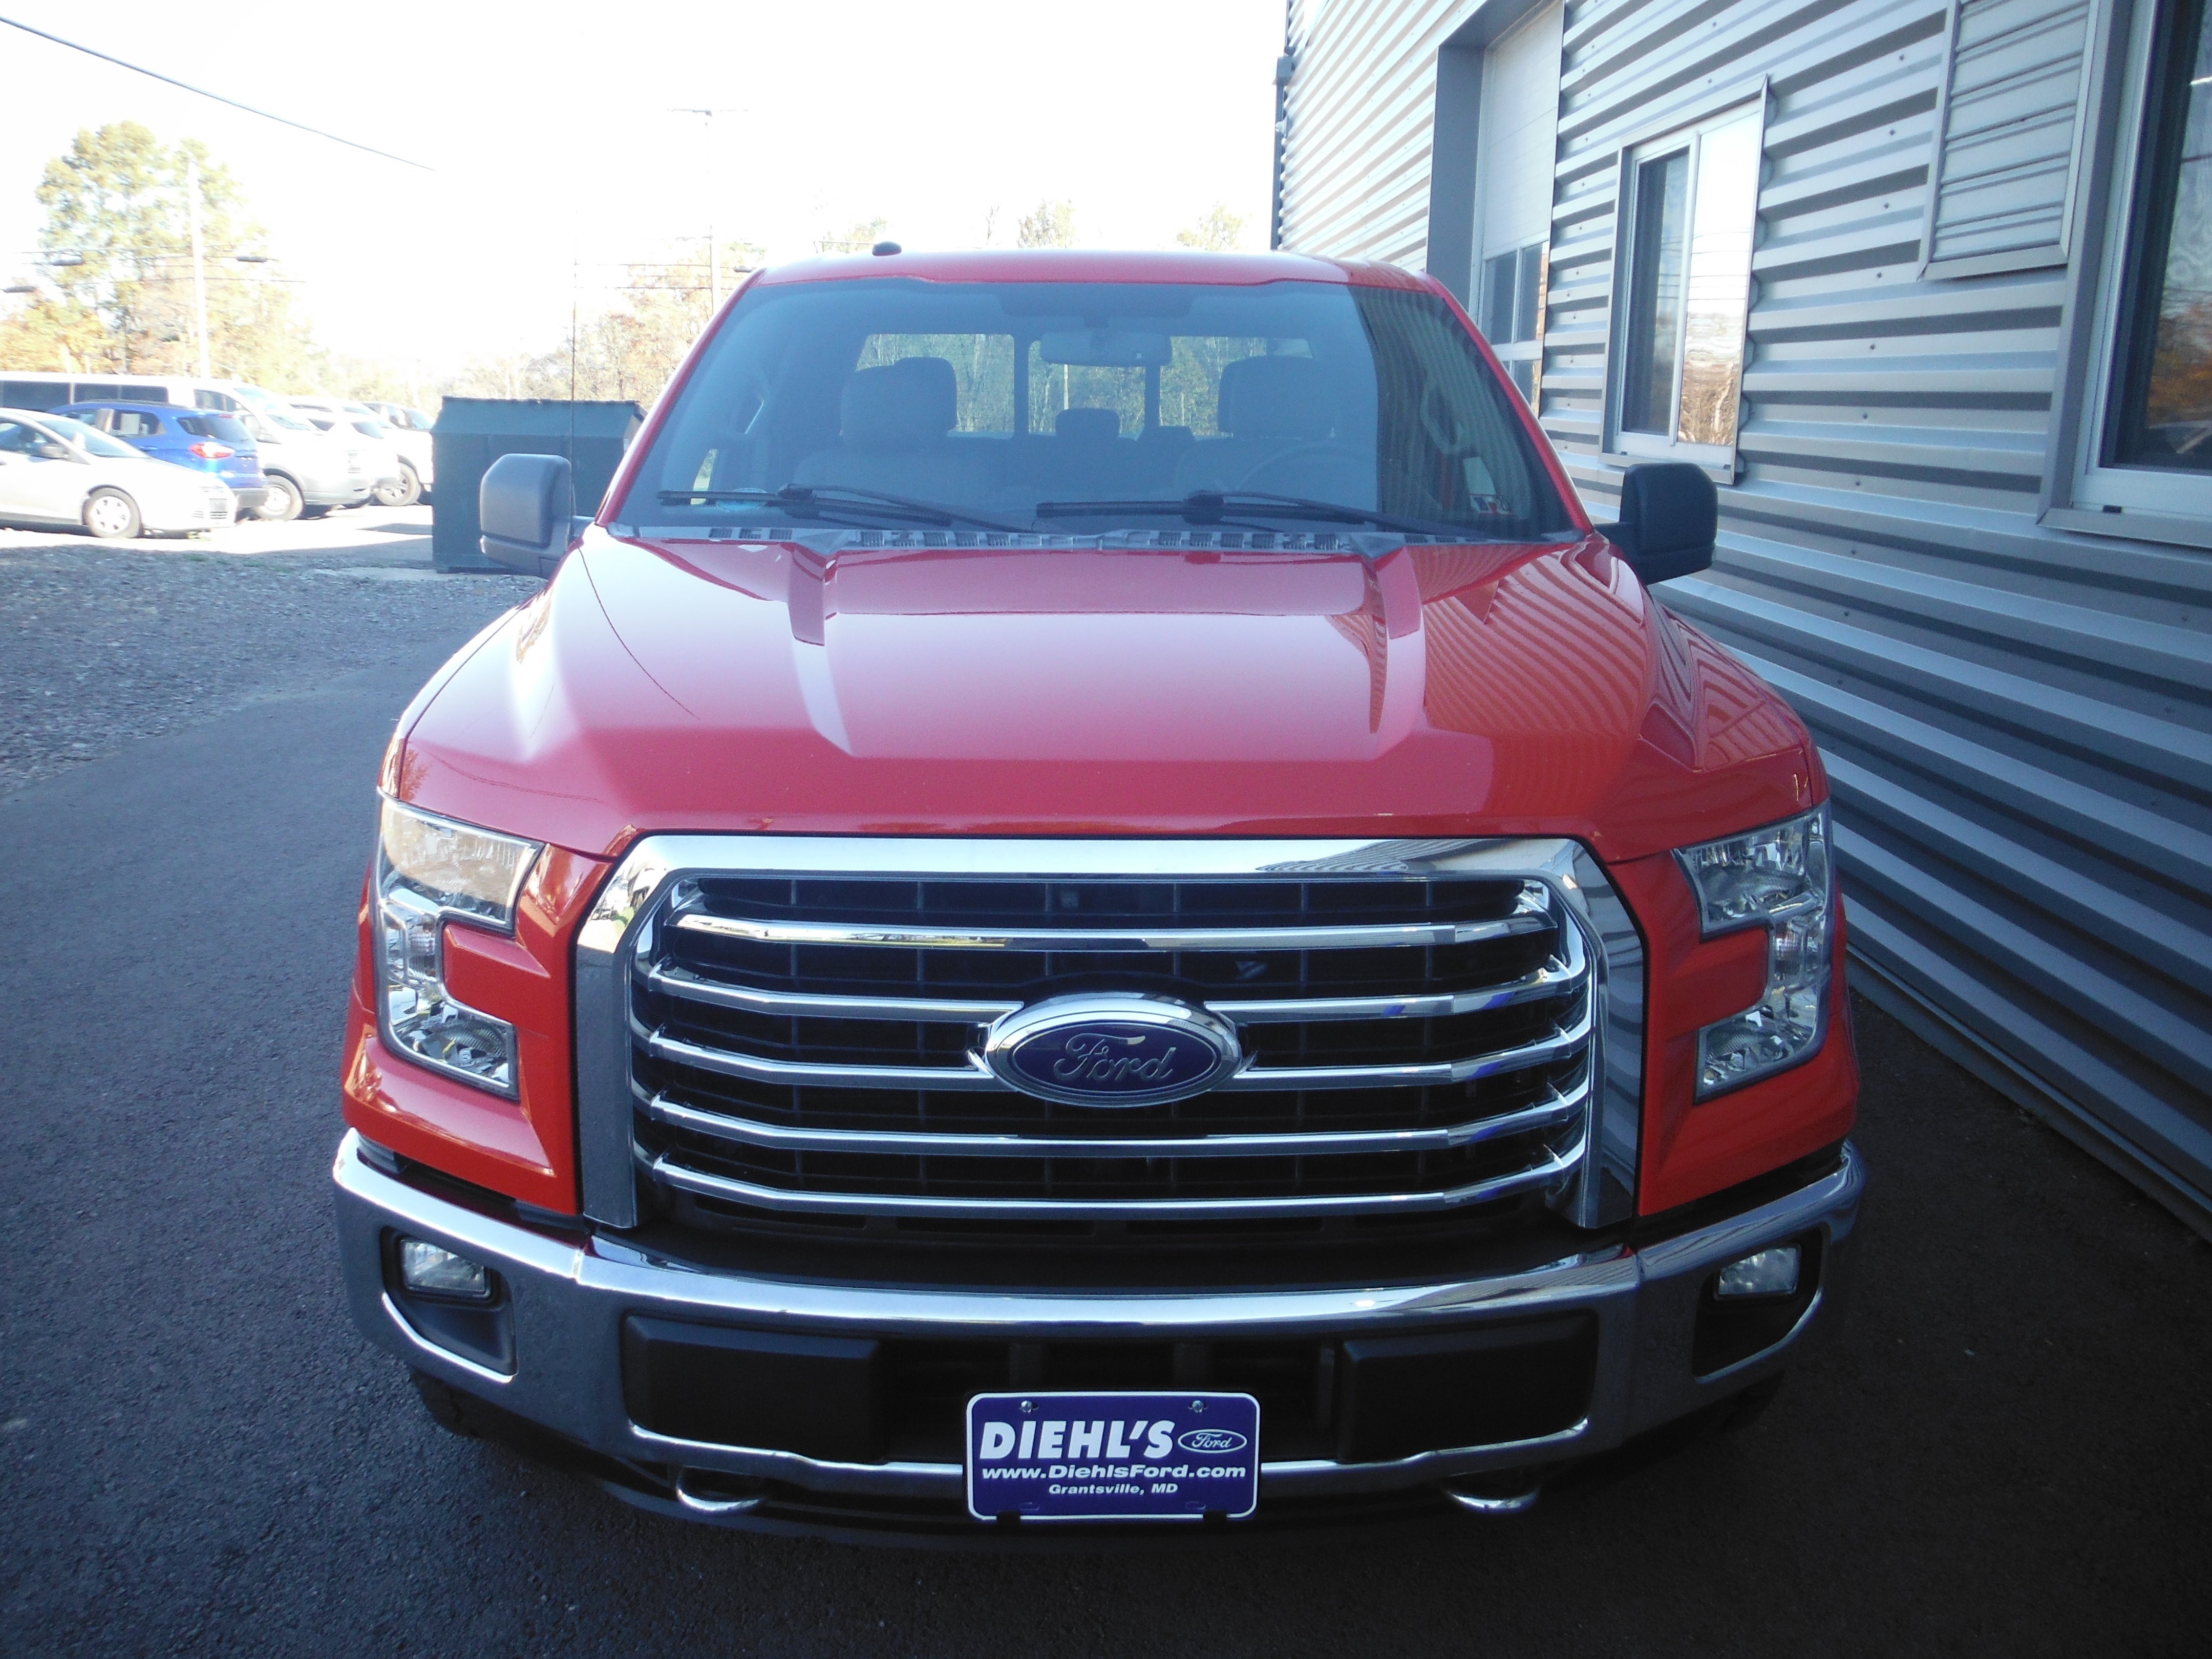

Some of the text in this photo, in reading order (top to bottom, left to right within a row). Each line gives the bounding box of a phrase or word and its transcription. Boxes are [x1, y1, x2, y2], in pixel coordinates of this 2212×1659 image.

[1053, 1033, 1177, 1081] Ford
[979, 1420, 1176, 1459] DIEHL'S
[1192, 1433, 1232, 1448] Ford
[982, 1464, 1246, 1479] www.DiehlsFord.com
[1048, 1483, 1179, 1496] Grantsville, MD
